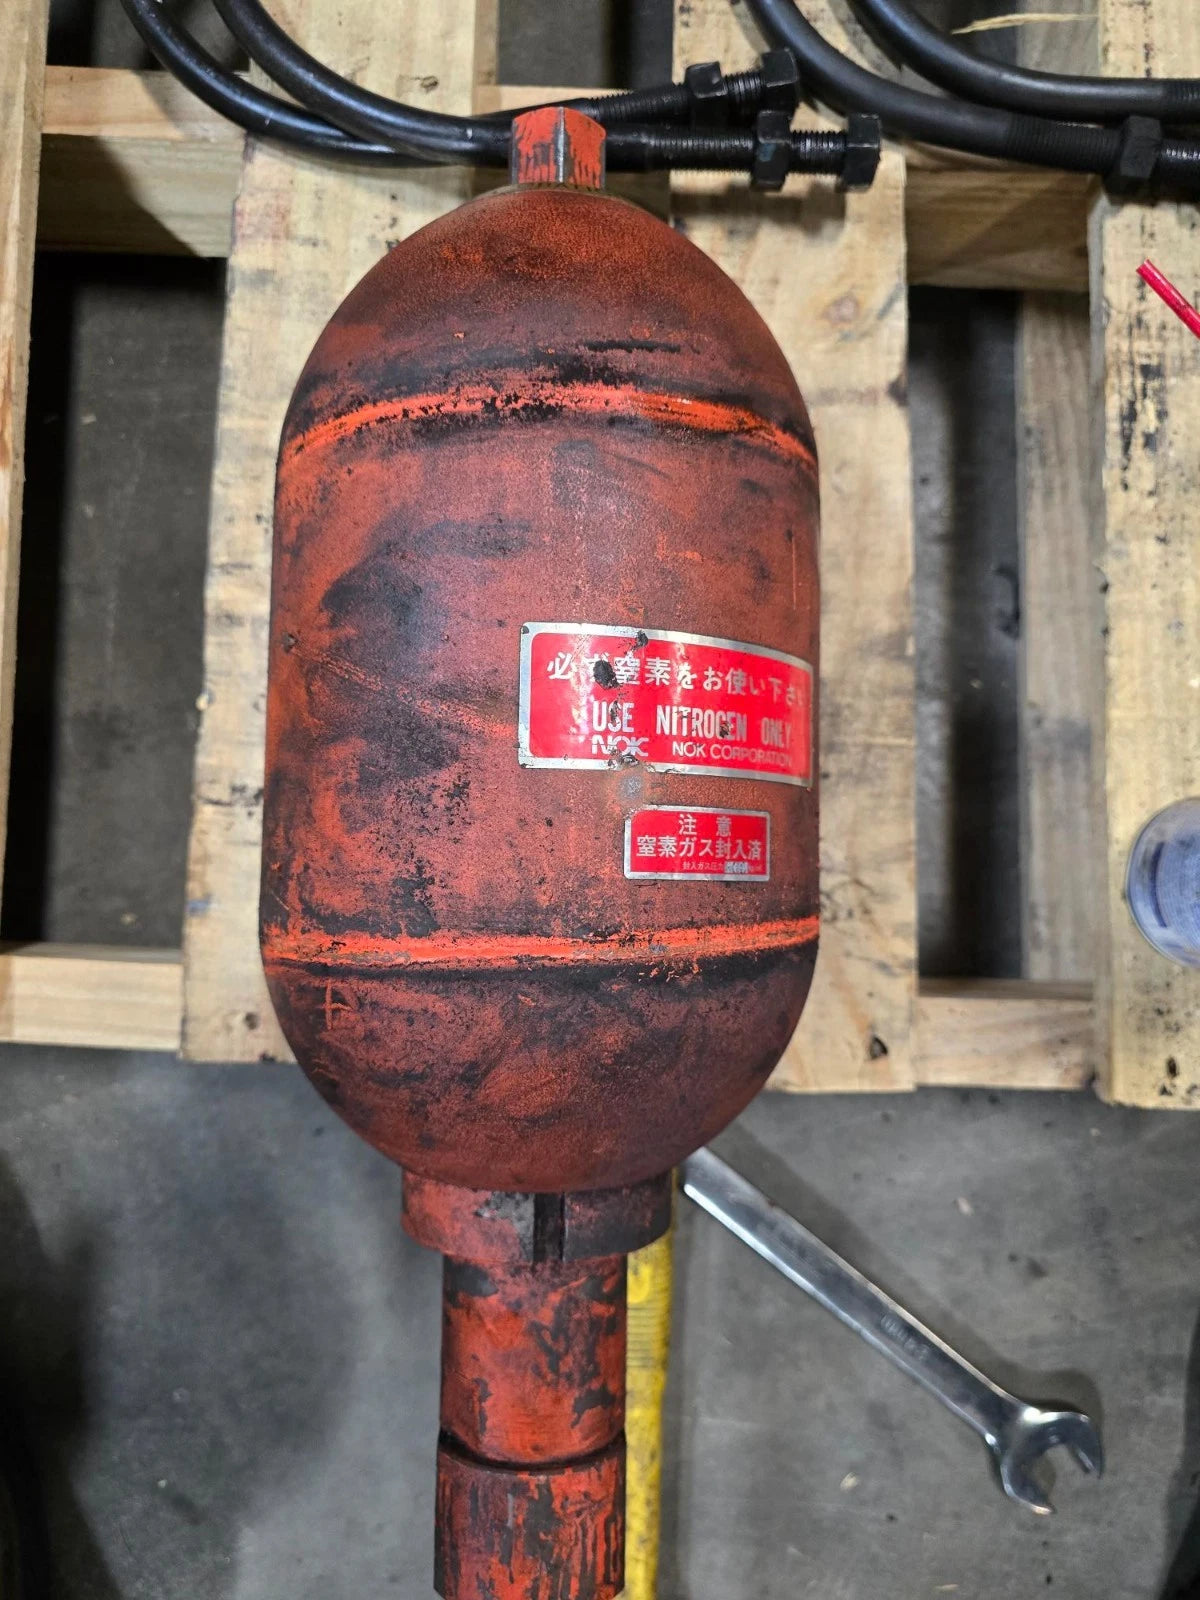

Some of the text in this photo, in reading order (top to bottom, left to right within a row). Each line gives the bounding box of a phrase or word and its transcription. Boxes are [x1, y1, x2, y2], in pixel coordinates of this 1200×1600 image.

[592, 701, 792, 749] USE NITROGEN ONLY
[591, 734, 650, 757] NOK
[672, 741, 792, 768] NOK CORPORATION
[636, 835, 762, 860] 窒素ガス封入済
